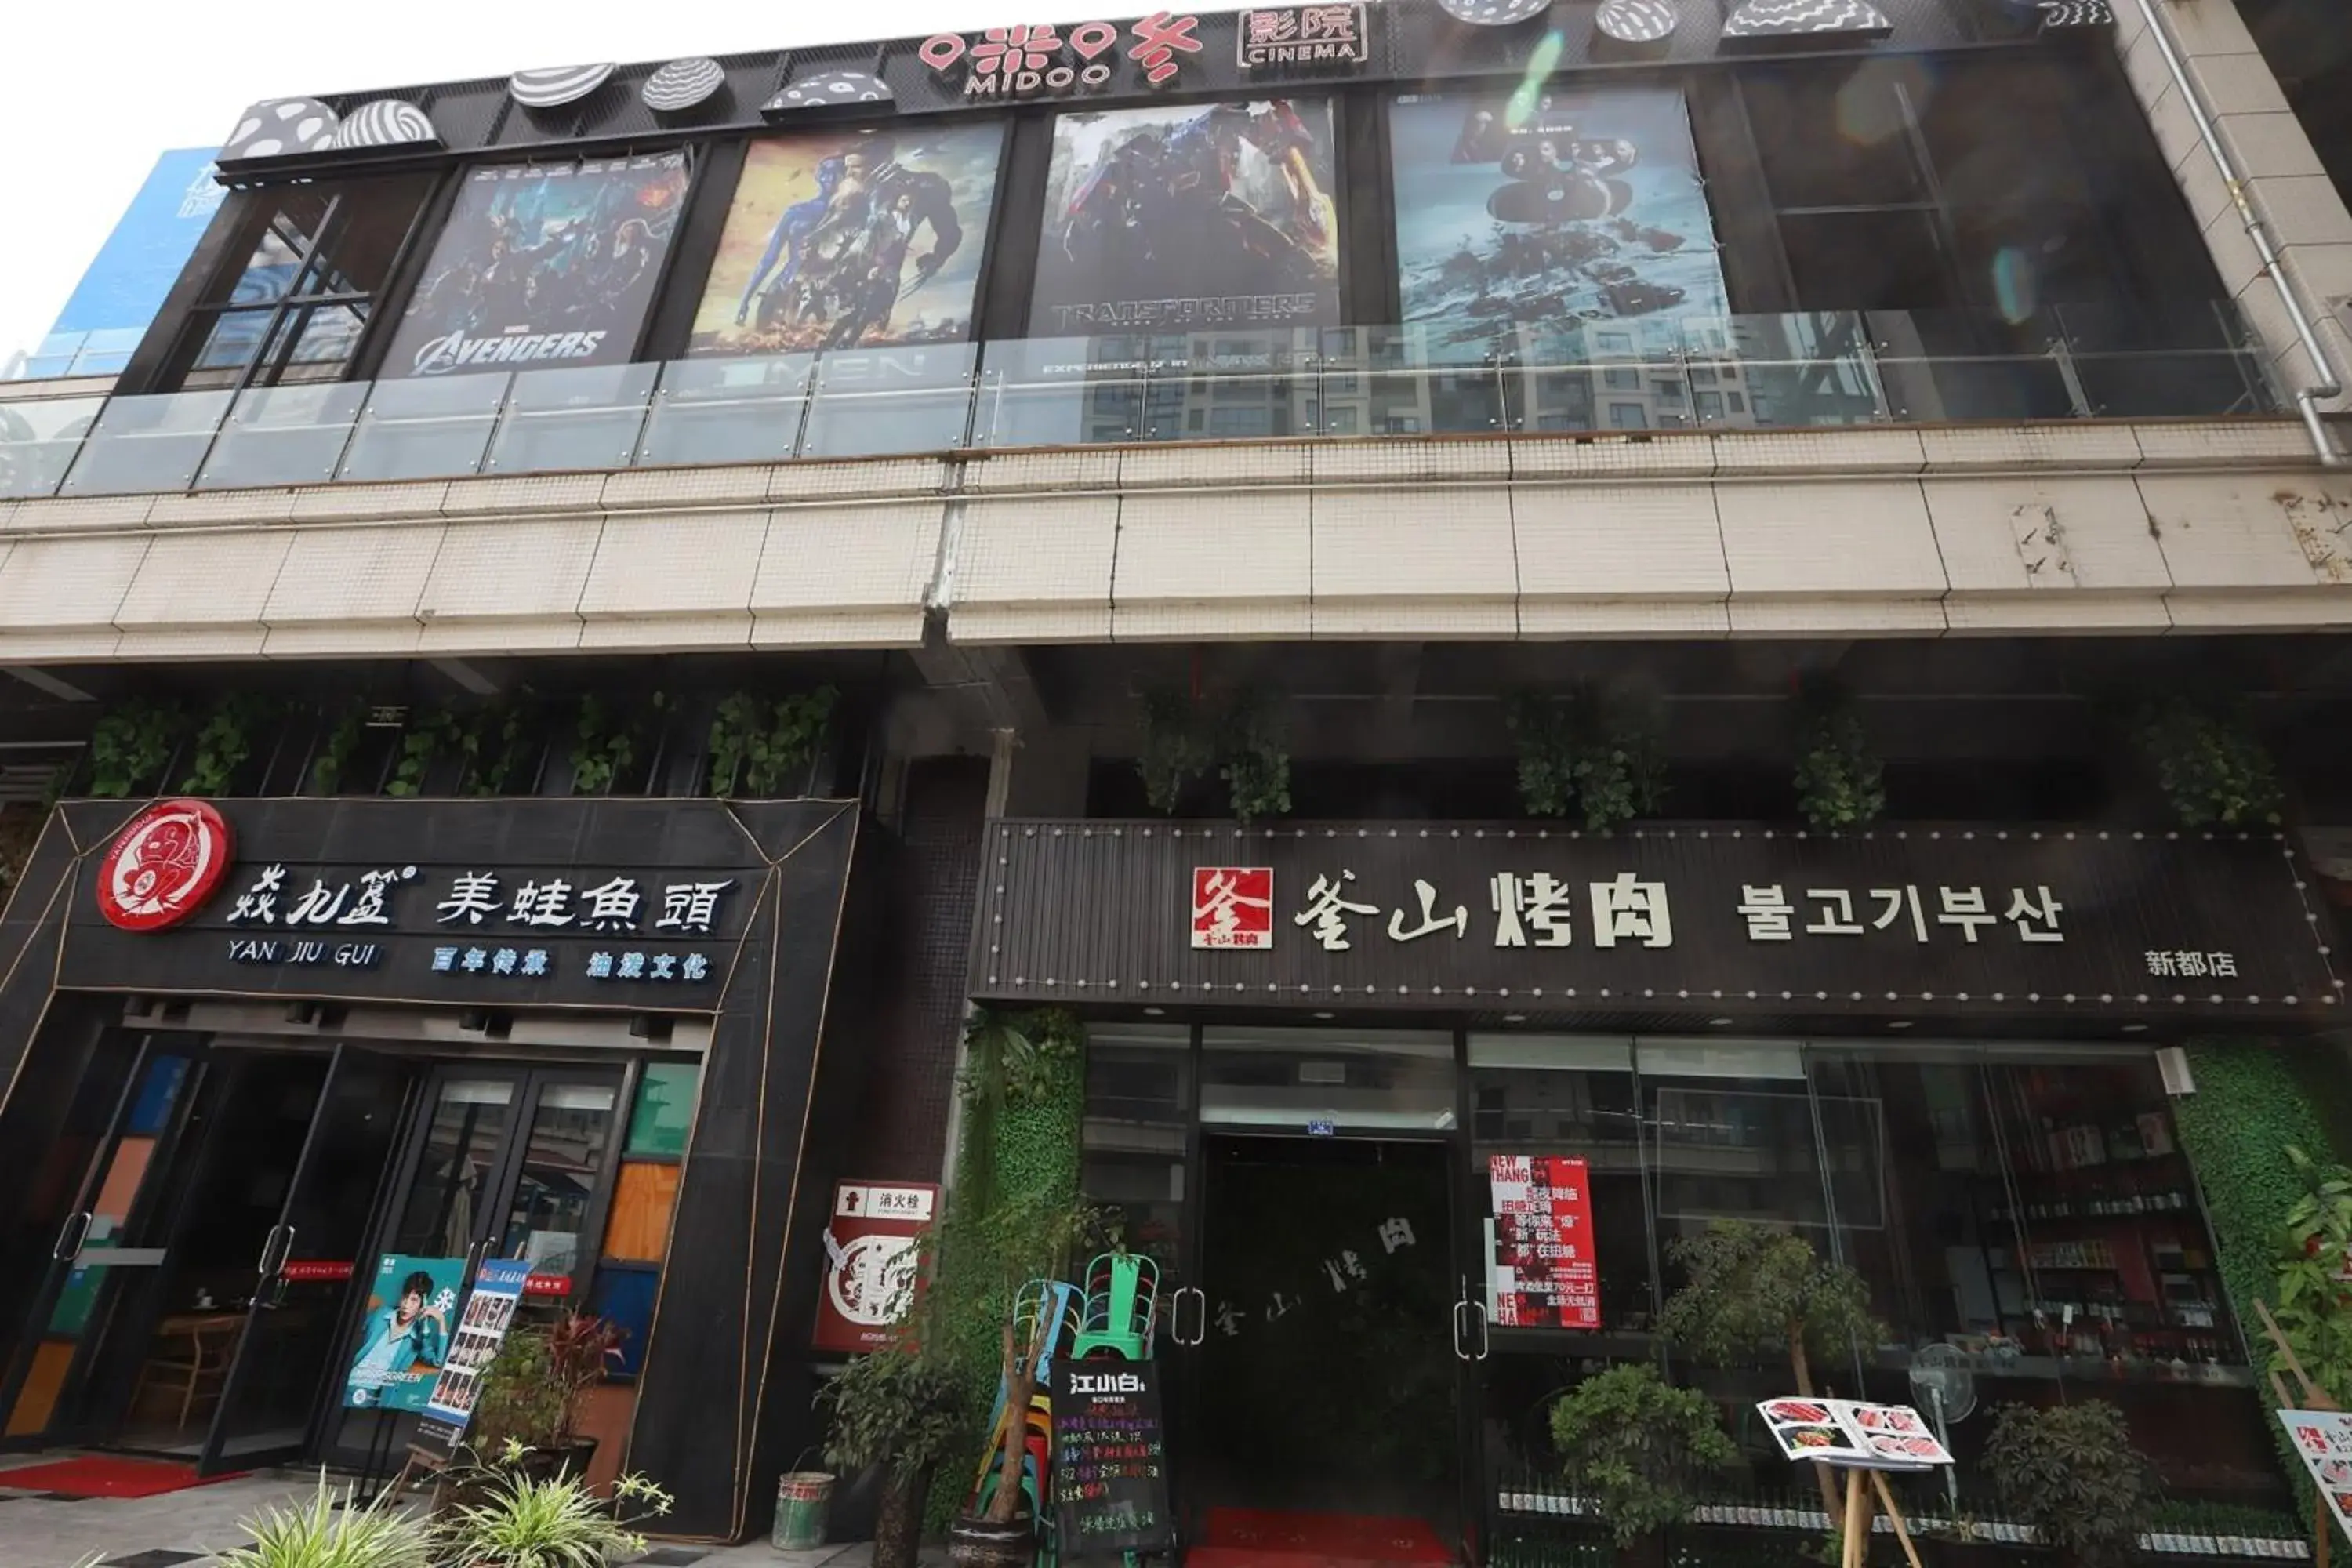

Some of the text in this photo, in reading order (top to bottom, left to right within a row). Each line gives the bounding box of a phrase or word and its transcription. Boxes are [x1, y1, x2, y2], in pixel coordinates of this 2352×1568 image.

[1250, 6, 1355, 42] 影院
[1248, 43, 1356, 64] CINEMA
[965, 64, 1111, 95] MIDOO
[409, 330, 608, 376] AVENGERS
[1294, 869, 1674, 950] 釜山烤肉
[1737, 884, 2064, 943] 불고기부산
[230, 941, 376, 965] YAN JIU GUI
[2144, 950, 2238, 978] 新都店
[879, 1192, 920, 1208] 消火栓
[1069, 1373, 1138, 1395] 江小白
